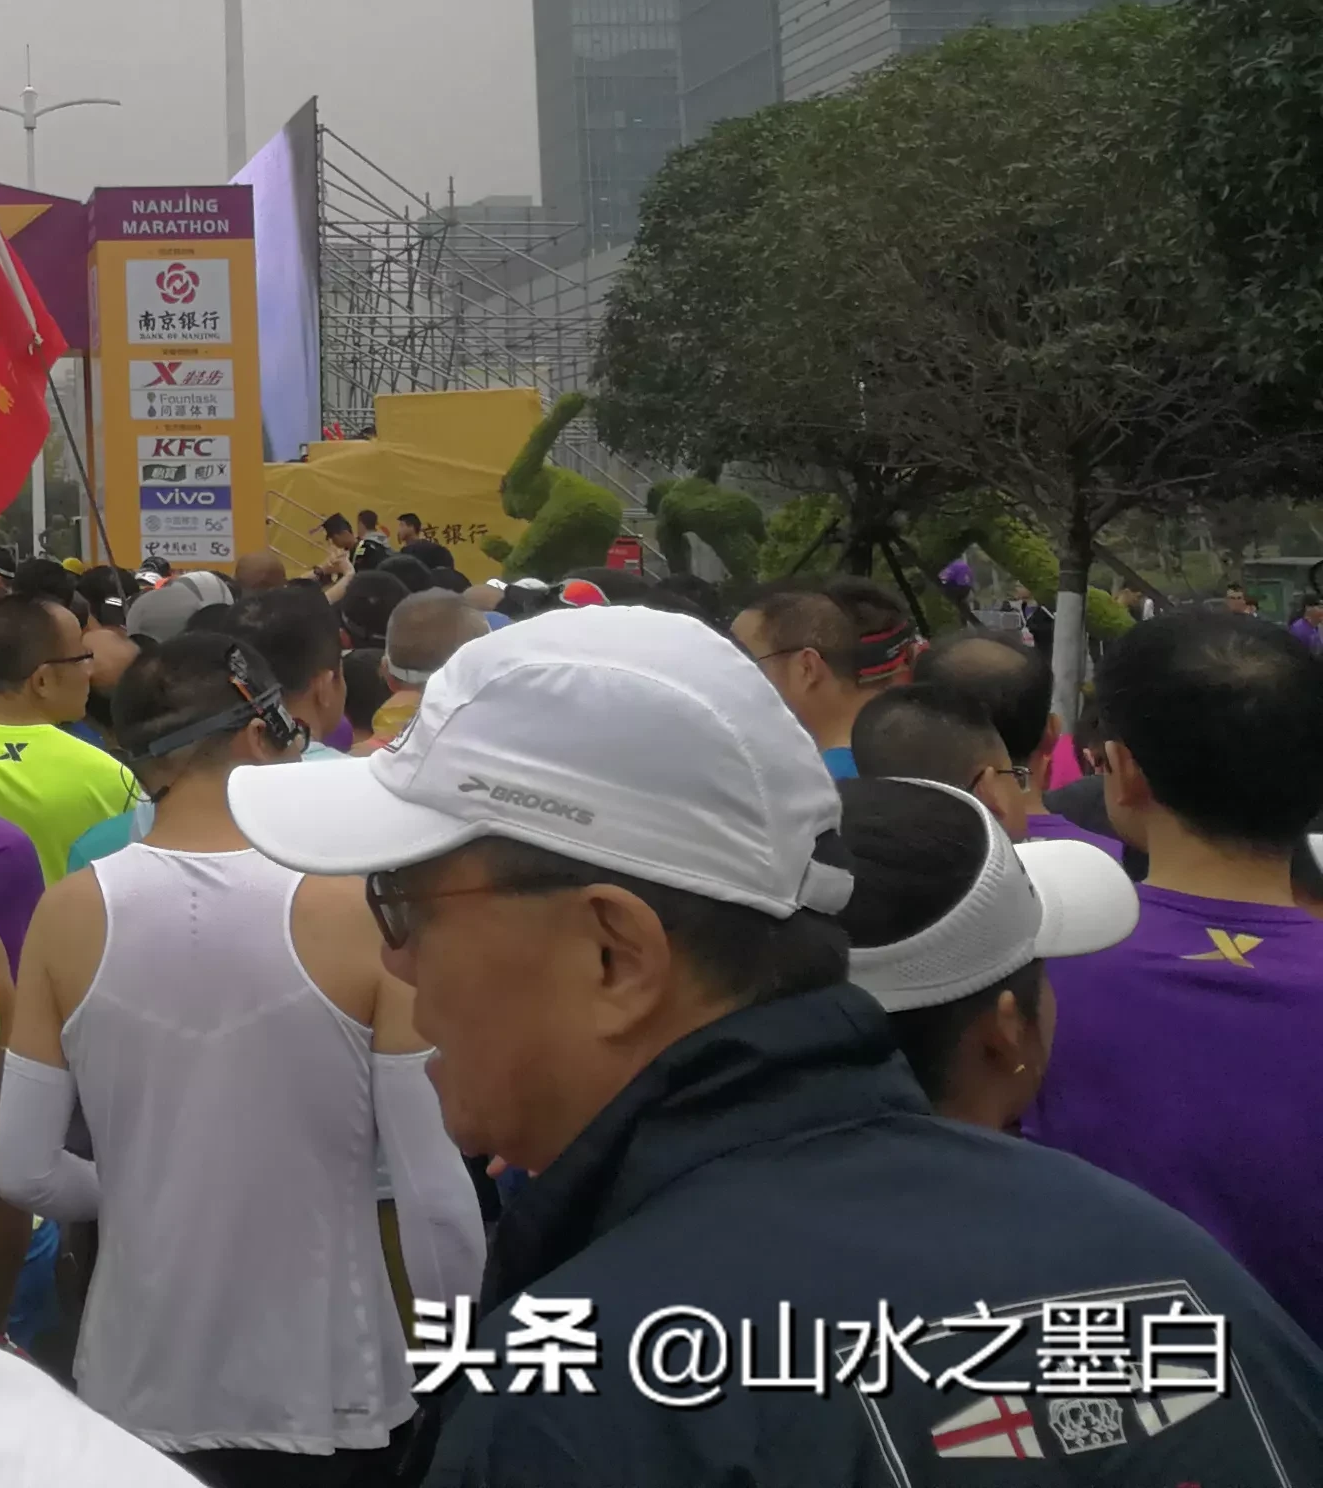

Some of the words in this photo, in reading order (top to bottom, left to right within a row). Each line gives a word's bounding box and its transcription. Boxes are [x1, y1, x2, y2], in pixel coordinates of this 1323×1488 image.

[132, 190, 219, 214] NANJING
[122, 219, 230, 234] MARATHON
[139, 310, 220, 331] 南京银行
[151, 438, 215, 458] KFC
[489, 785, 596, 826] BROOKS
